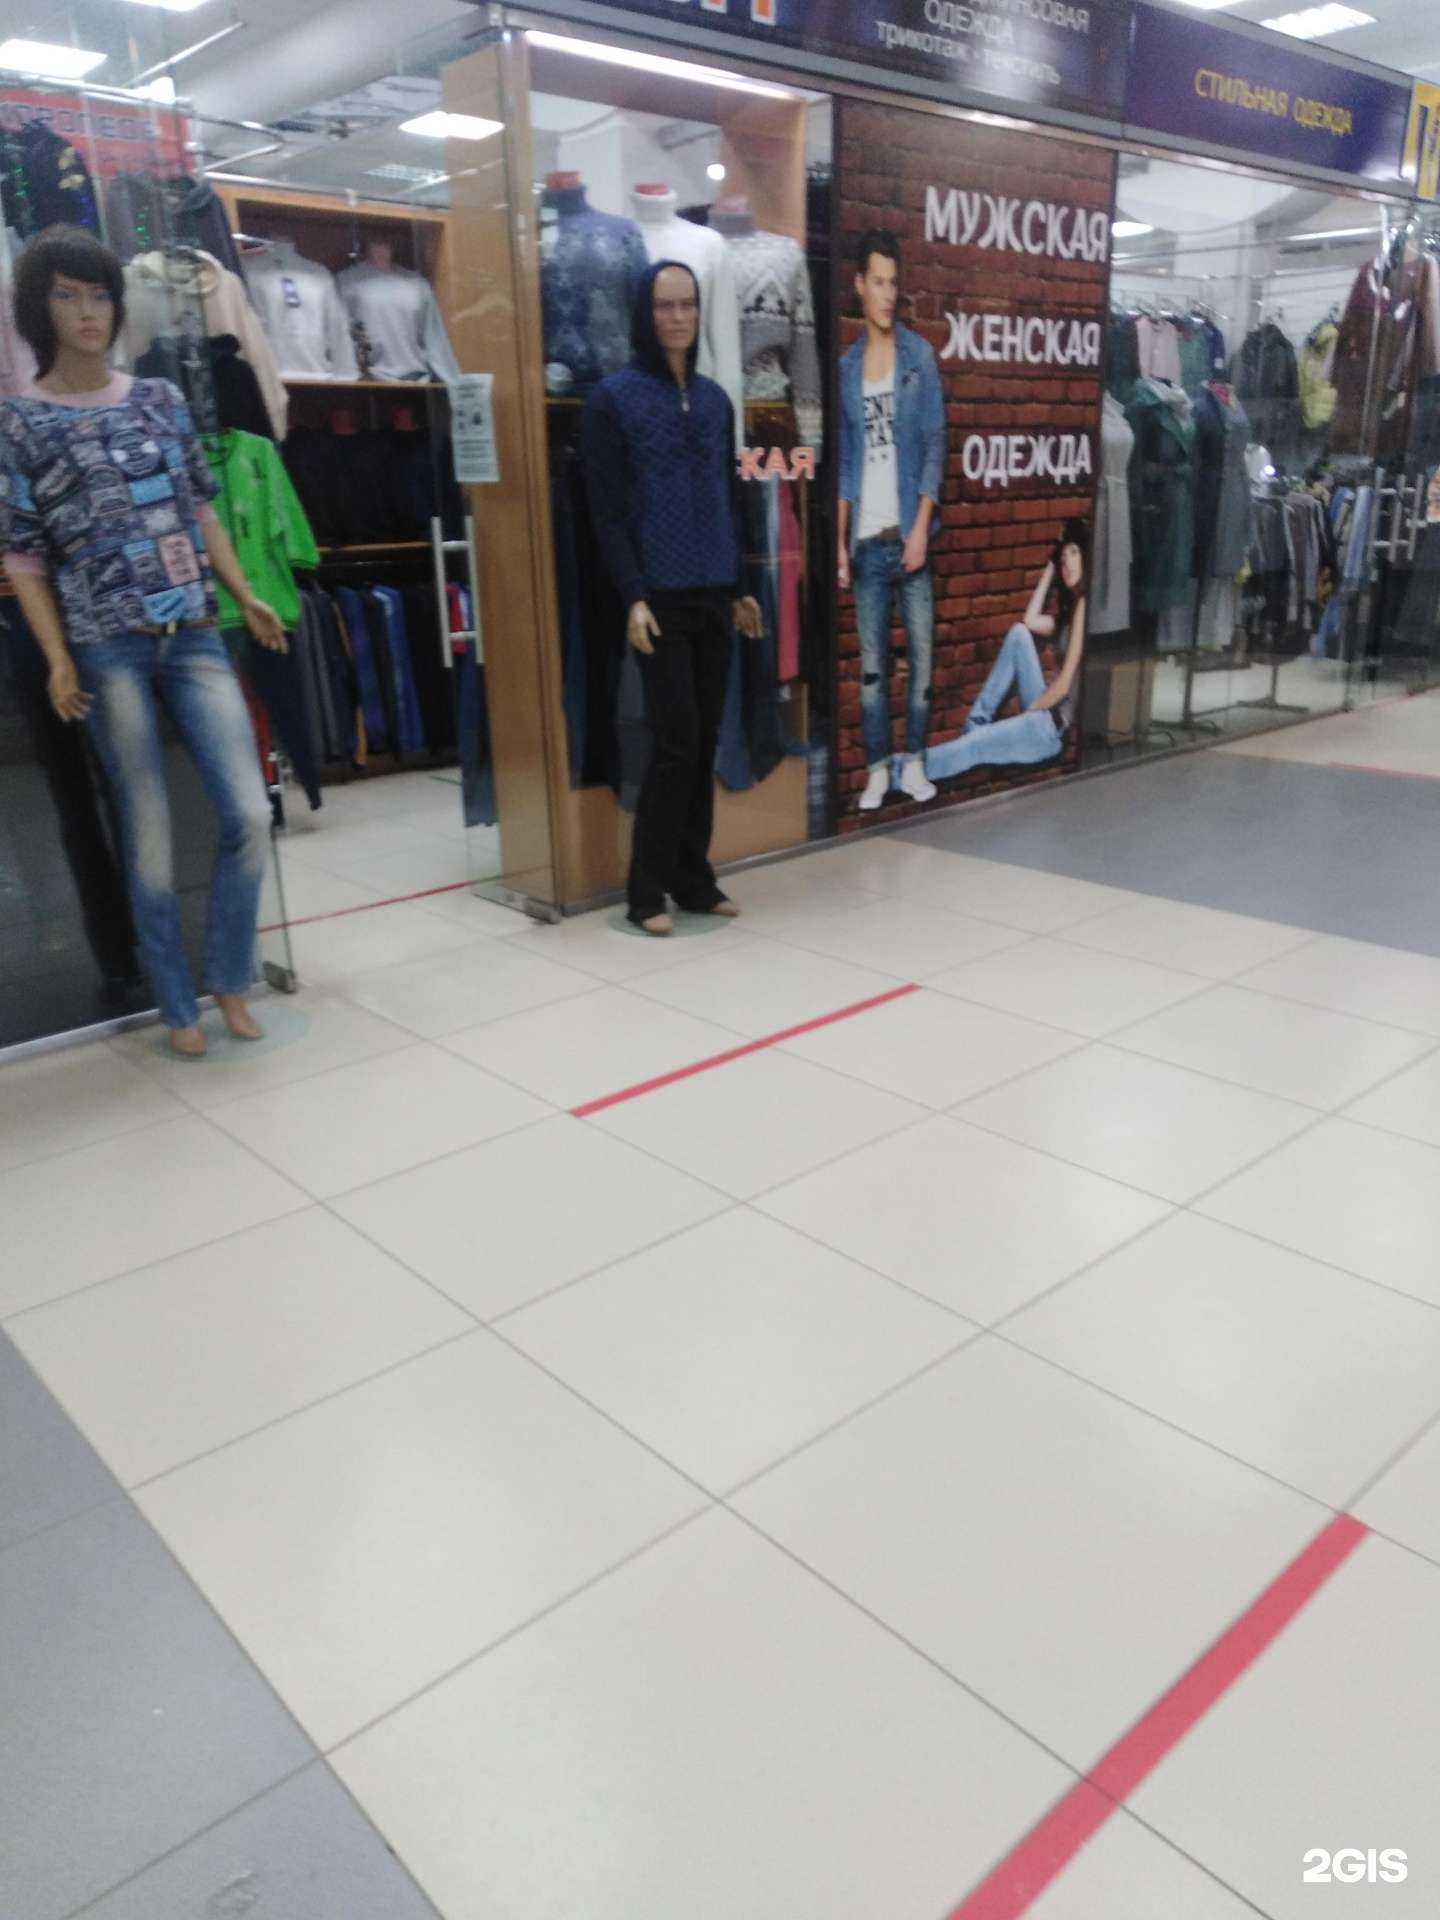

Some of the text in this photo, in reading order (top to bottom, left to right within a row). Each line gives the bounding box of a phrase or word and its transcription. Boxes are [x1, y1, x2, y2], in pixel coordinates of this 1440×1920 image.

[1194, 68, 1353, 136] СТИЛЬНАЯ ОДЕЖДА
[925, 185, 1109, 263] МУЖСКАЯ
[939, 312, 1101, 367] ЖЕНСКАЯ
[736, 446, 816, 481] КАЯ
[962, 433, 1093, 488] ОДЕЖДА
